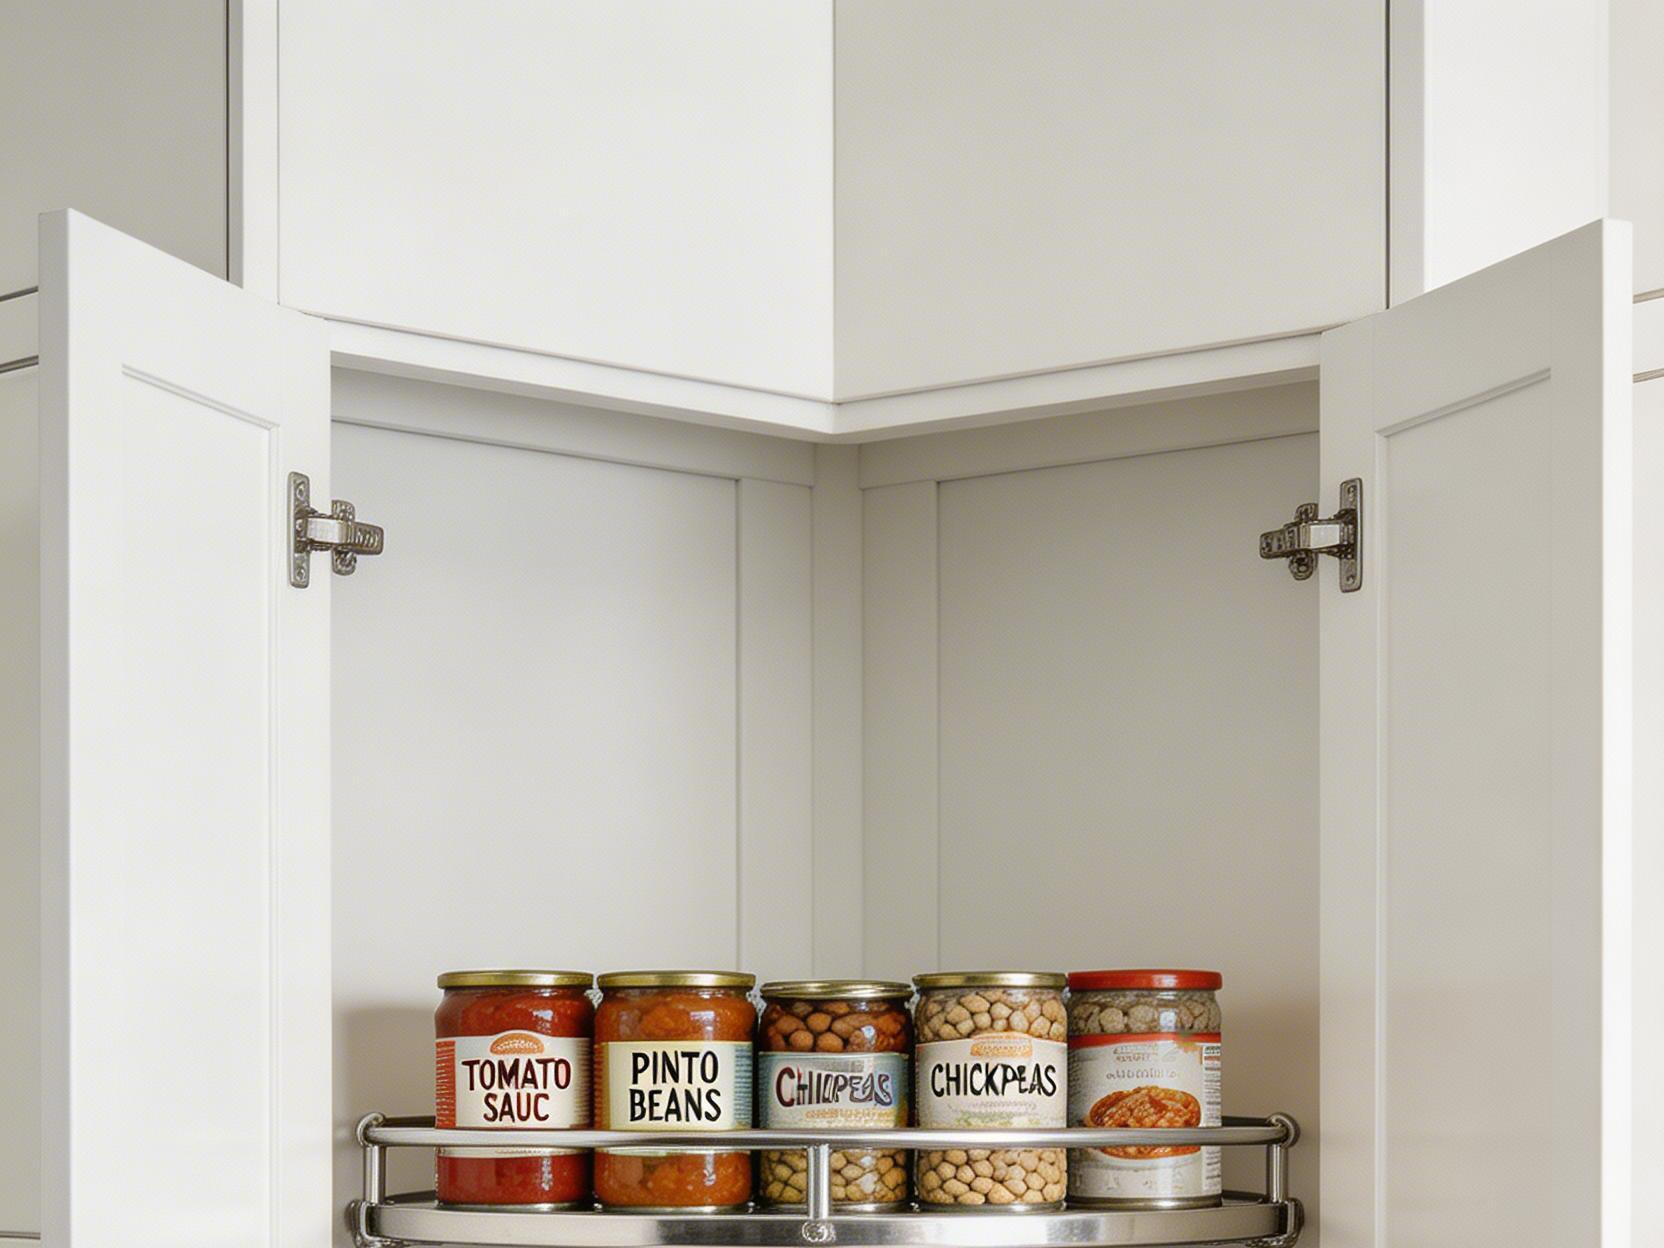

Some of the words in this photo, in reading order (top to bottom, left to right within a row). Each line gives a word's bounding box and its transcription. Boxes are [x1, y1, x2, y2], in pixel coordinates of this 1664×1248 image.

[462, 1057, 571, 1091] TOMATO
[632, 1050, 719, 1085] PINTO
[931, 1063, 1057, 1097] CHICKPEAS
[483, 1092, 550, 1123] SAUC
[629, 1087, 722, 1122] BEANS
